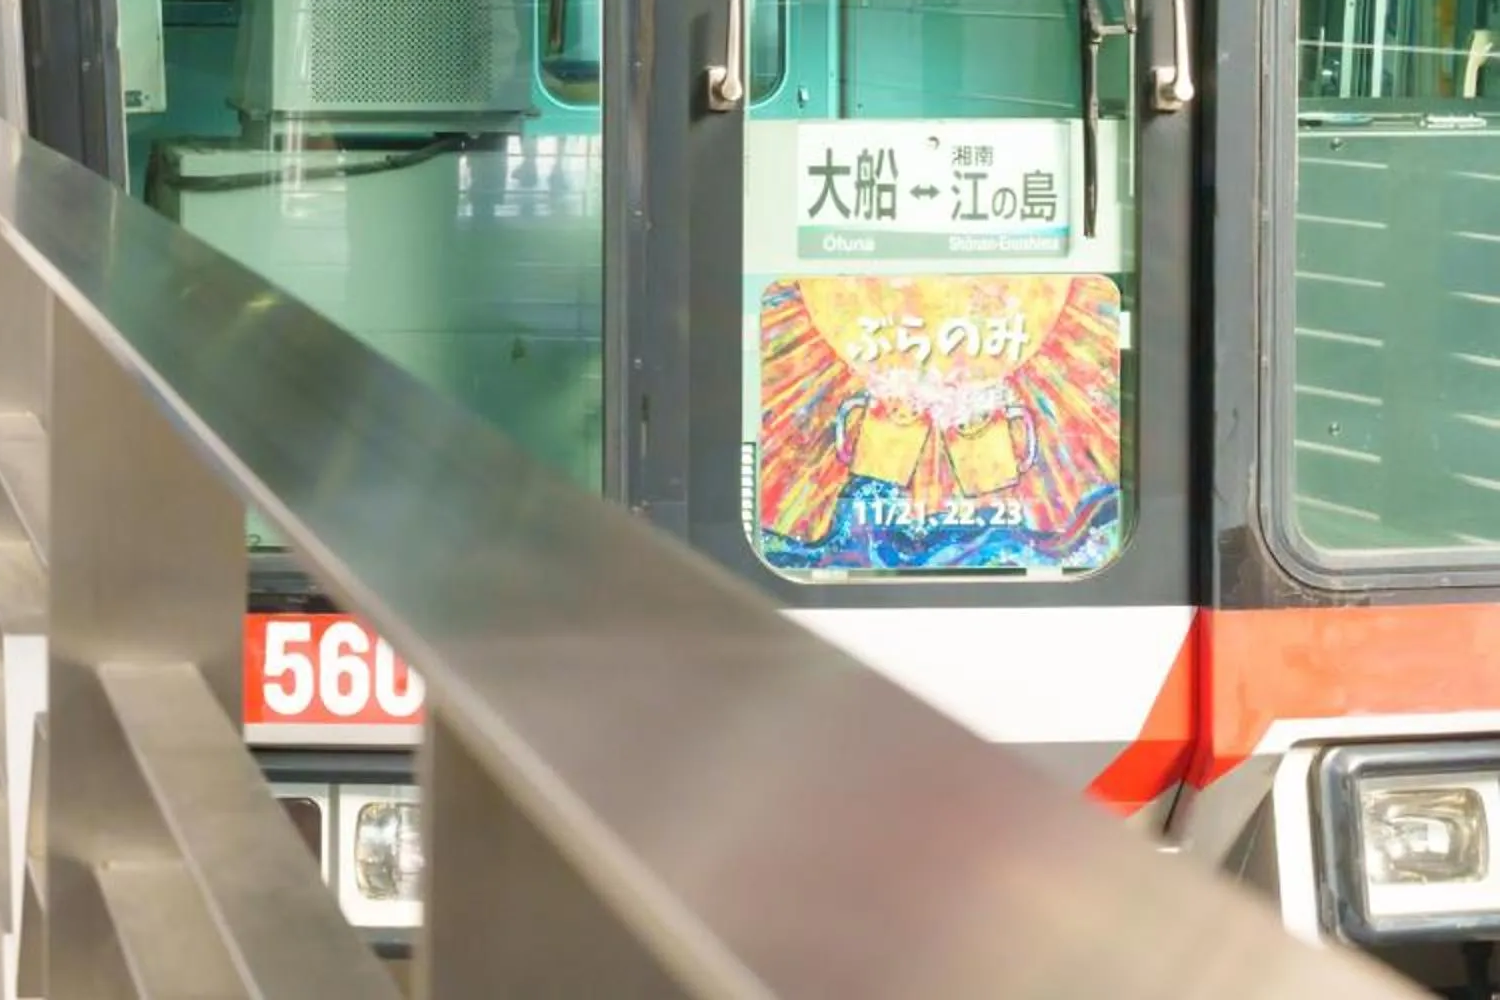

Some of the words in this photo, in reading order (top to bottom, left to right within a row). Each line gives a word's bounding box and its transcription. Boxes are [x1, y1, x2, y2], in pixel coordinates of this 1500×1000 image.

[951, 145, 994, 167] 湘南
[807, 147, 899, 221] 大船
[951, 169, 1058, 222] 江の島
[847, 313, 1032, 366] ぶらのみ
